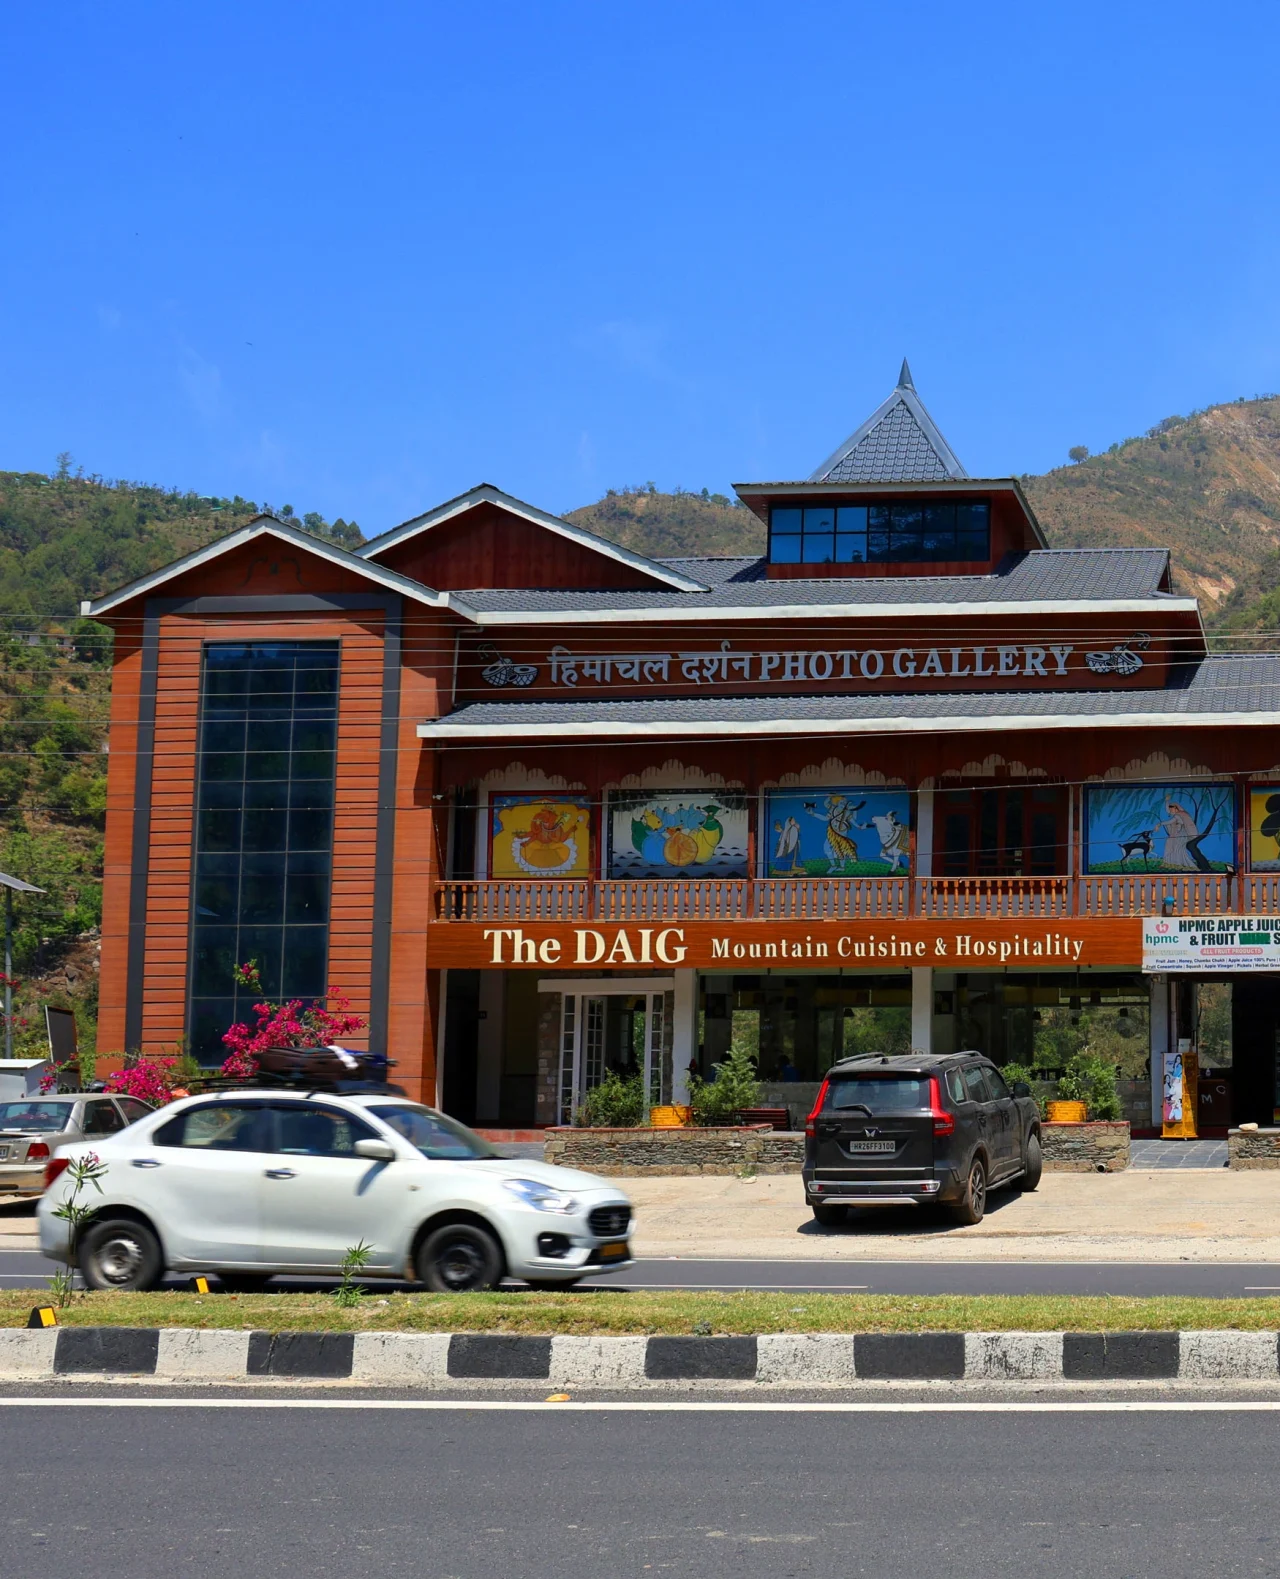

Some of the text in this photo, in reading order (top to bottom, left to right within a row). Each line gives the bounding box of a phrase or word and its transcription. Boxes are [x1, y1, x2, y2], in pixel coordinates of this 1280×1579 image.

[547, 640, 754, 687] हिमाचल दर्शन
[759, 646, 1074, 680] PHOTO GALLERY
[1145, 933, 1179, 945] hpmc
[1178, 920, 1214, 932] HPMC
[1217, 919, 1254, 932] APPLE
[1189, 935, 1199, 946] &
[1201, 933, 1236, 945] FRUIT
[483, 928, 689, 964] The DAIG
[711, 933, 1084, 961] Mountain Cuisine & Hospitality
